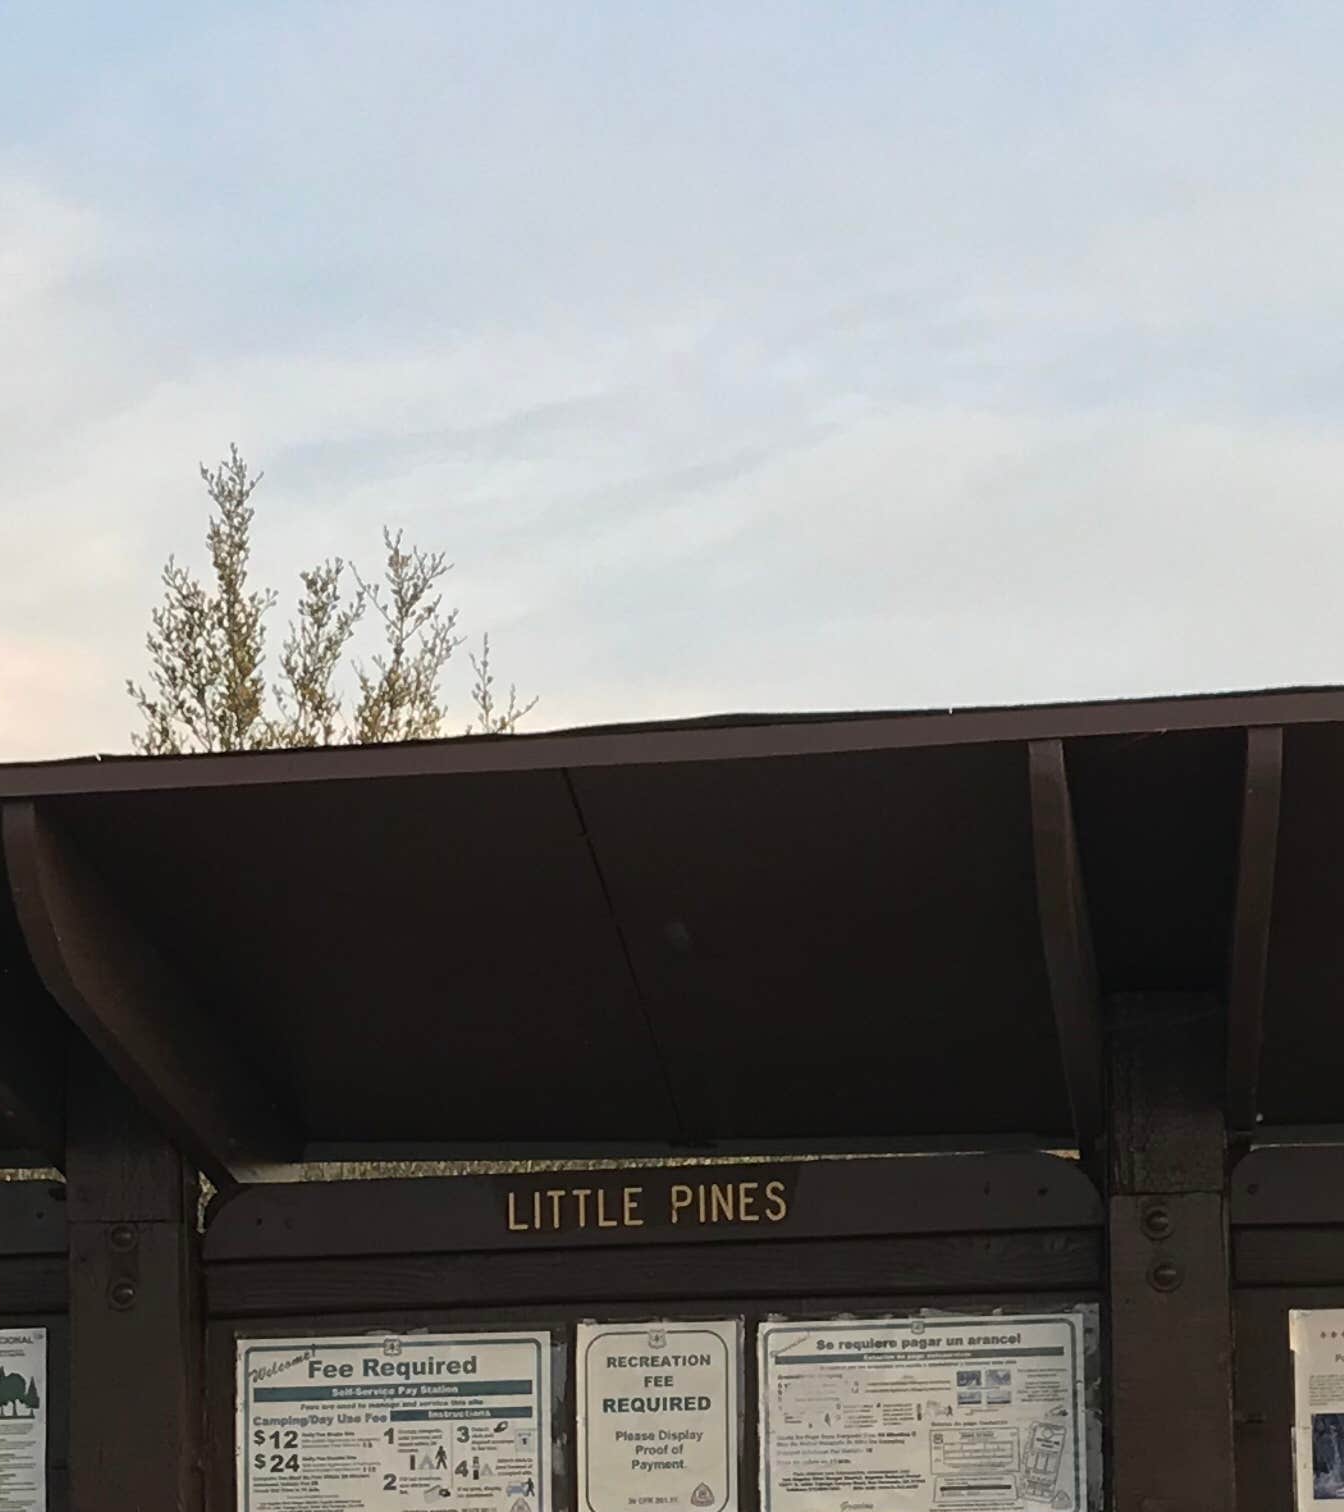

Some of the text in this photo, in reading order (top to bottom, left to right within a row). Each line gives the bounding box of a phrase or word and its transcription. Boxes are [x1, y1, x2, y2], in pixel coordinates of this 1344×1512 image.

[507, 1181, 787, 1231] LITTLE PINES
[816, 1332, 1022, 1352] Se requiere pagar un arancel
[307, 1355, 478, 1381] Fee Required
[606, 1353, 712, 1369] RECREATION
[643, 1375, 674, 1388] FEE
[330, 1384, 459, 1399] Self-Service Pay Station
[601, 1395, 712, 1414] REQUIRED
[336, 1412, 361, 1424] Use
[364, 1412, 388, 1423] Fee
[383, 1426, 395, 1445] 1
[456, 1425, 471, 1444] 3
[615, 1429, 704, 1443] Please Display
[634, 1443, 684, 1456] Proof of
[454, 1459, 470, 1478] 4
[382, 1472, 397, 1491] 2
